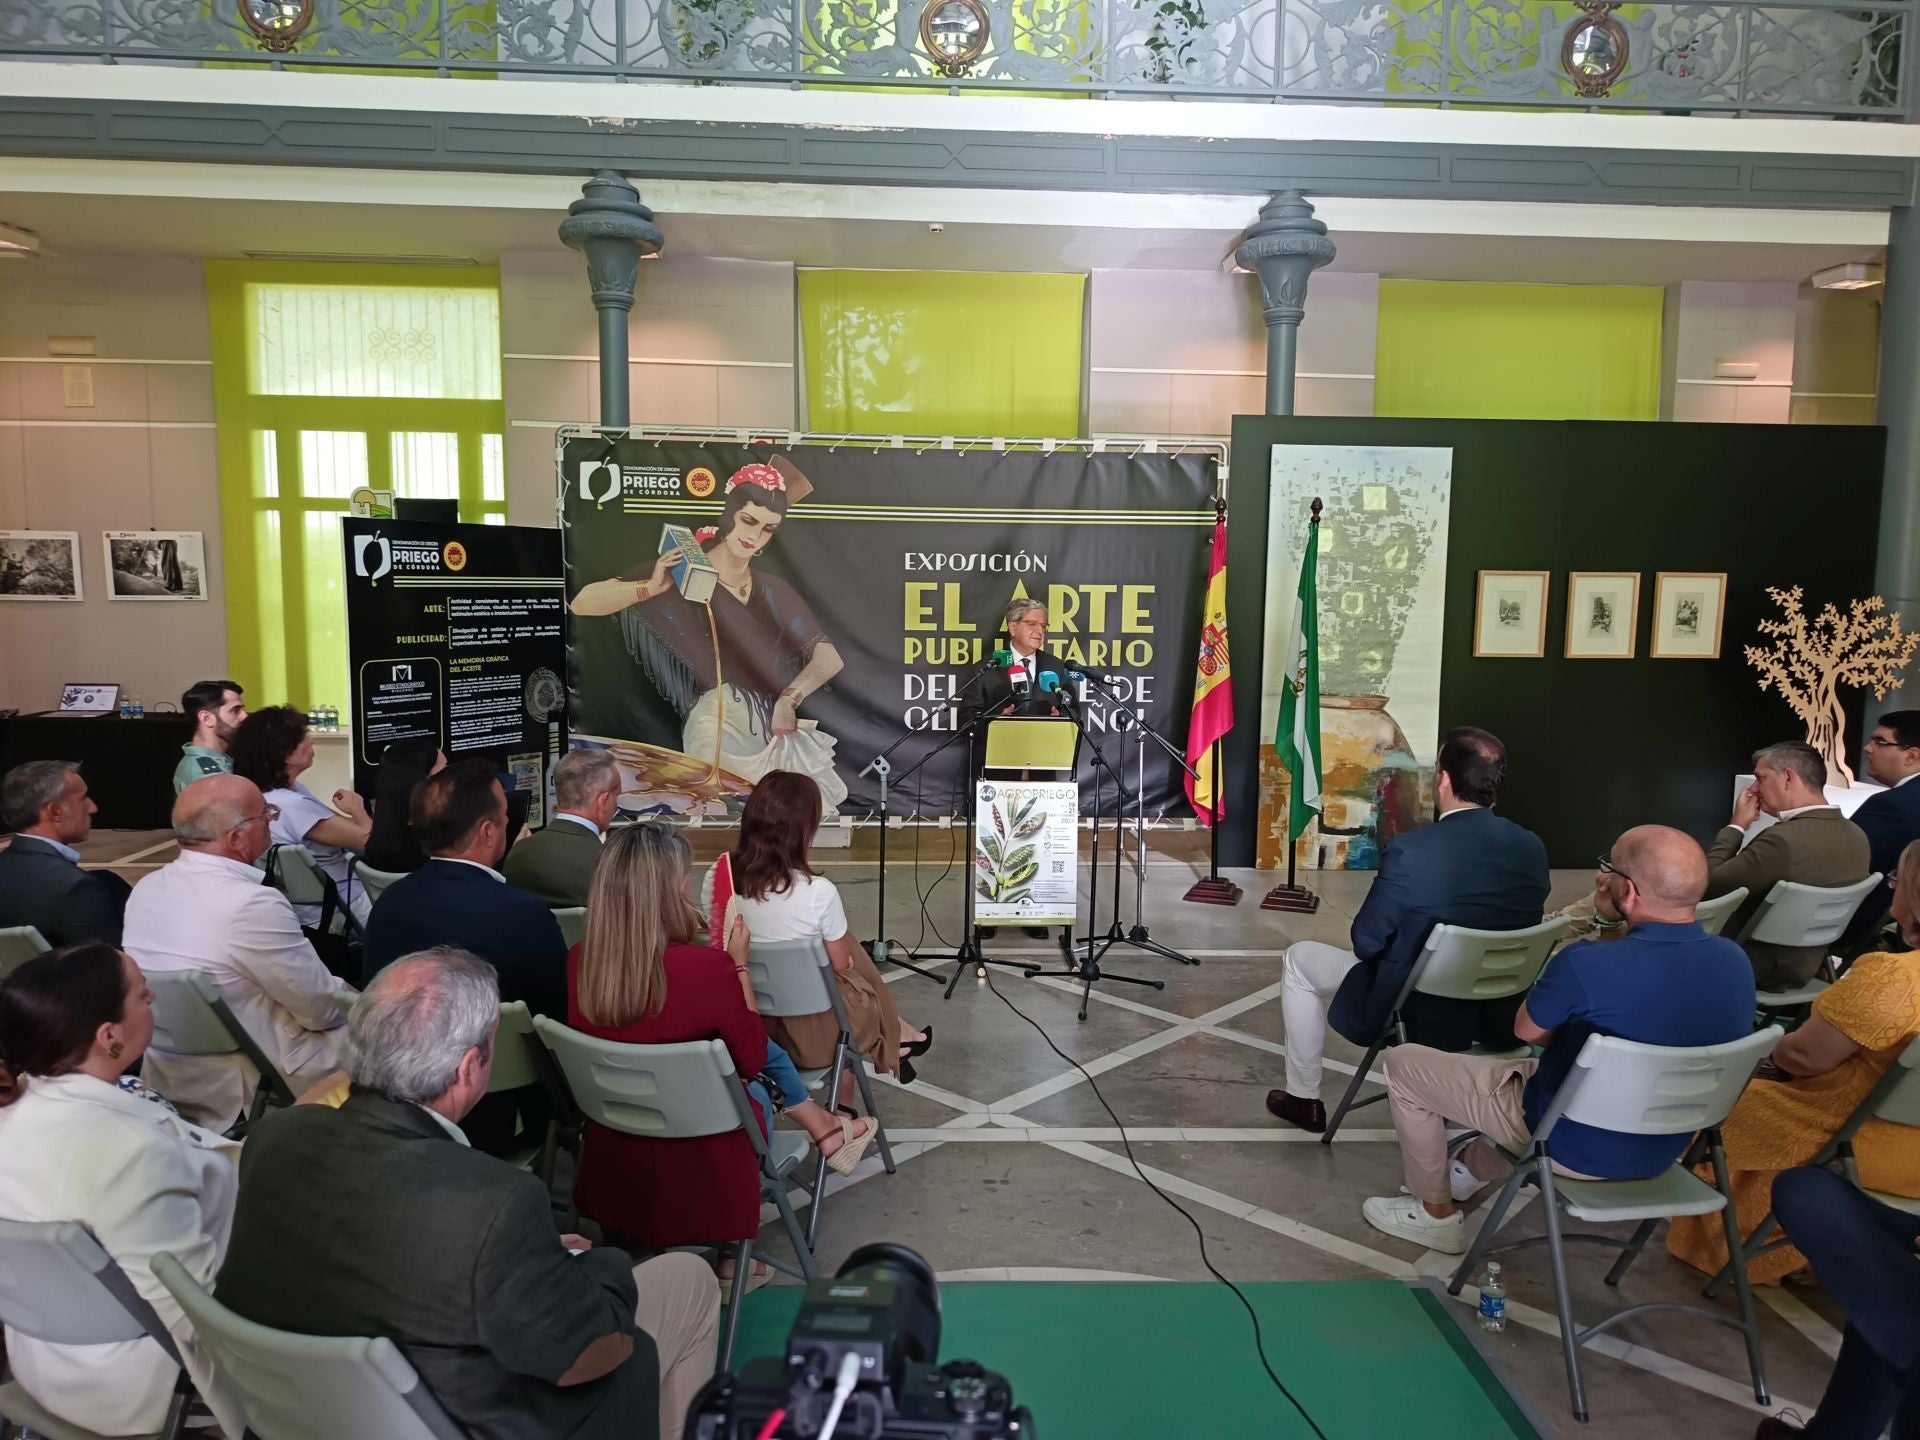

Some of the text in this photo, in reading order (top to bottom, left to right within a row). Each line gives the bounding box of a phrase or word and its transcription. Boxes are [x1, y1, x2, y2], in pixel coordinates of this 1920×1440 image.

[623, 476, 680, 489] PRIEGO
[392, 550, 440, 563] PRIEGO
[904, 550, 1048, 572] EXPOSICIÓN
[424, 605, 446, 613] ARTE:
[904, 582, 977, 632] EL
[396, 636, 447, 644] PUBLICIDAD:
[904, 674, 962, 701] DEL
[1112, 676, 1154, 702] DE
[997, 789, 1075, 800] AGROPRIEGO
